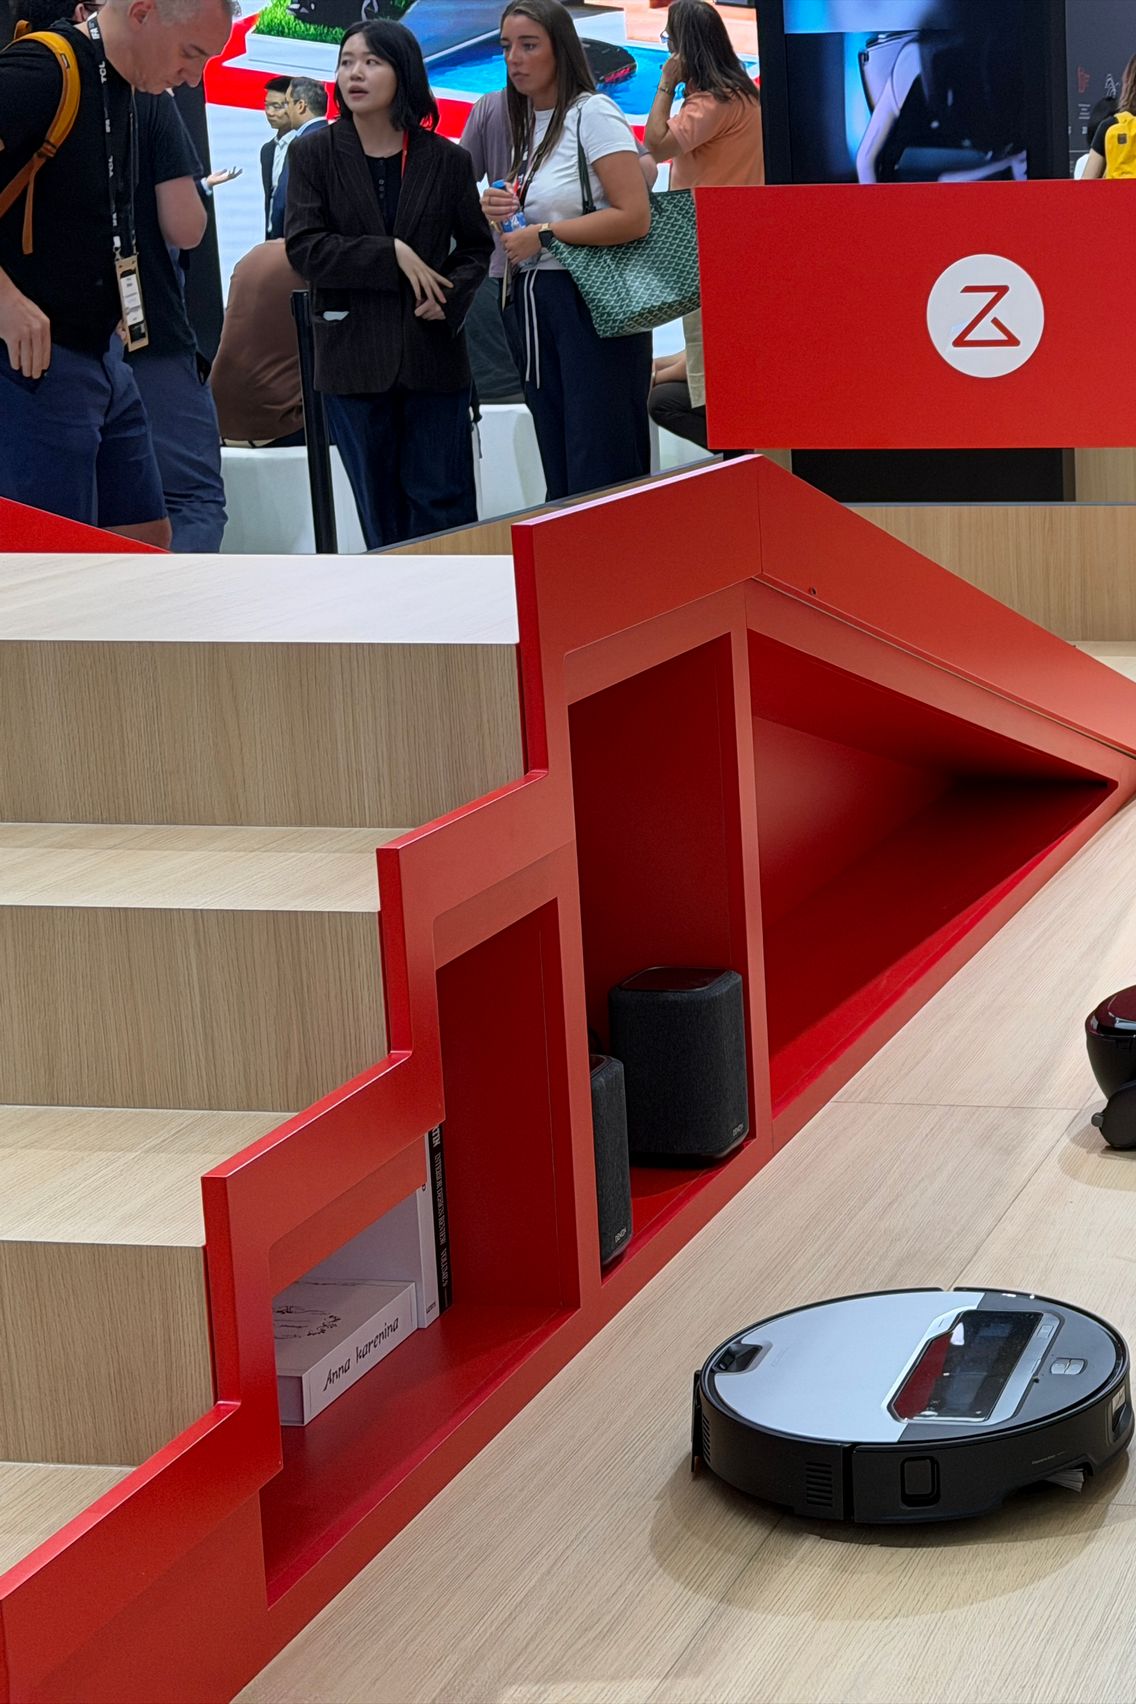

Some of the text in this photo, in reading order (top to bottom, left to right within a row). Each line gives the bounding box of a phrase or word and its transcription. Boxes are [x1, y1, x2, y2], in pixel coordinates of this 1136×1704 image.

[98, 60, 108, 84] TCL
[322, 1316, 399, 1392] Anna karenina
